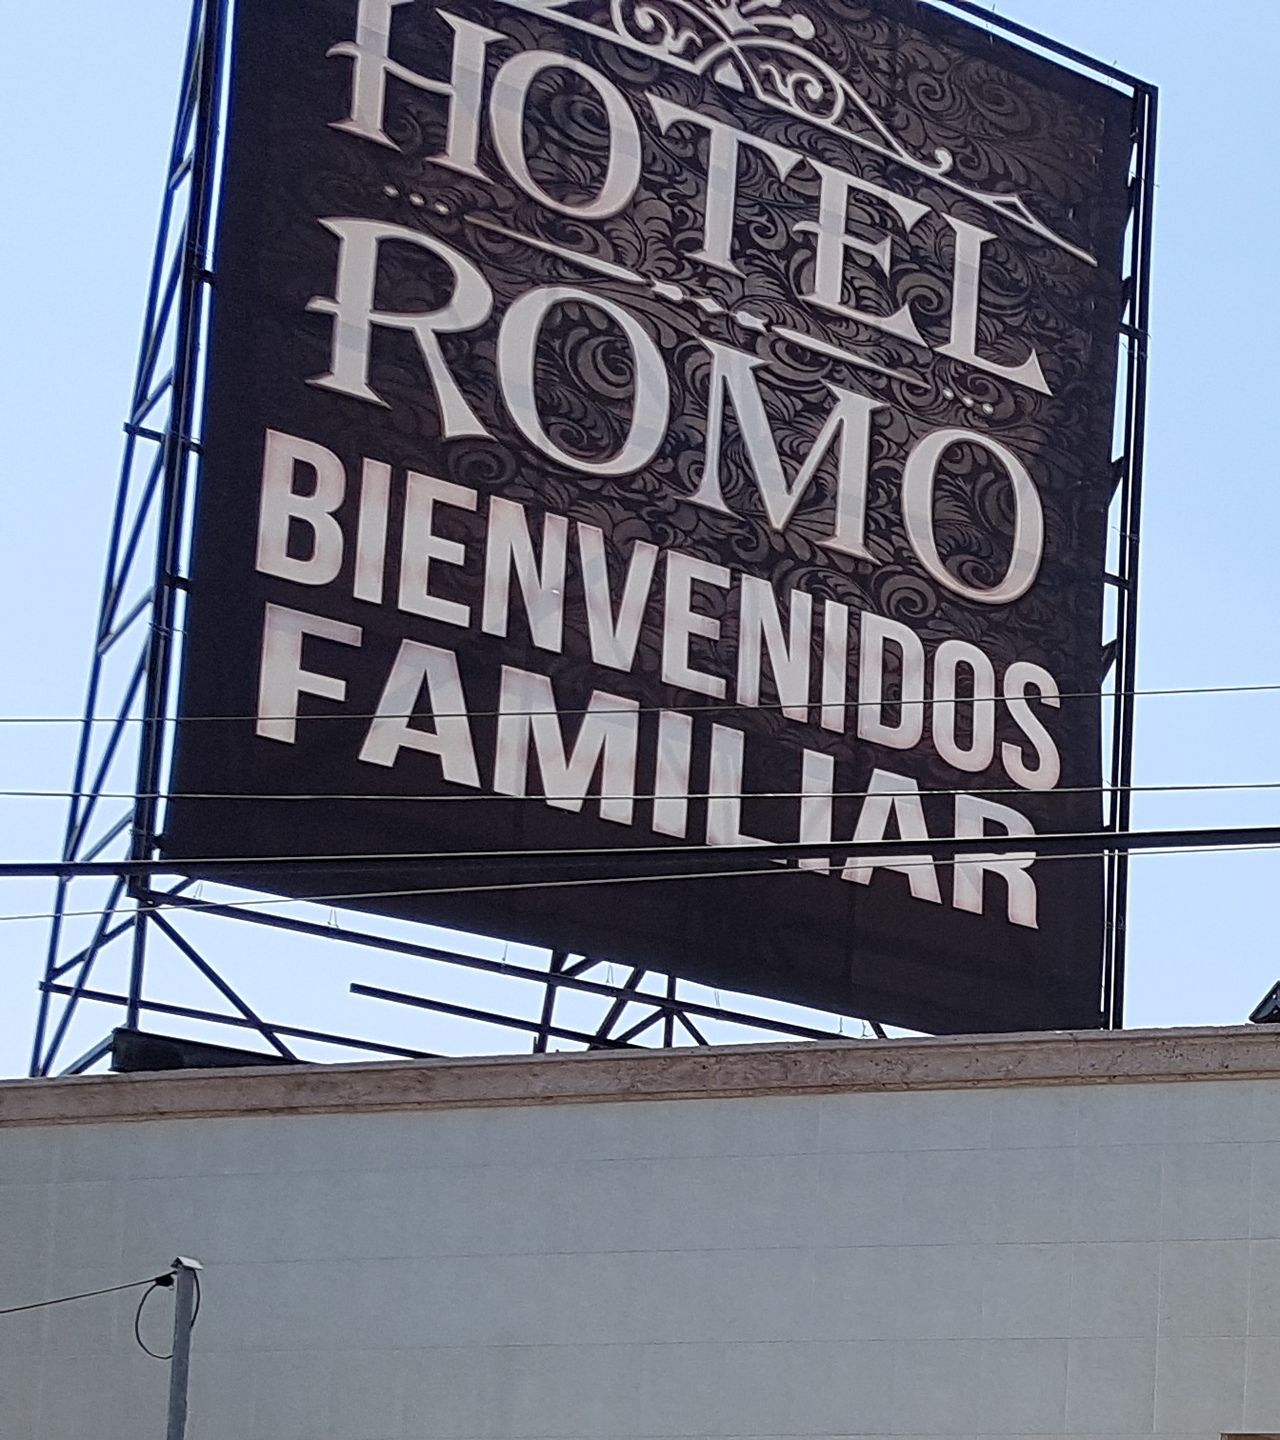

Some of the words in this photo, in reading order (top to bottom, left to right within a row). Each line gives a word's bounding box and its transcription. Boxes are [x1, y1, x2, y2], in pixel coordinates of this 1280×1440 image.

[325, 0, 1053, 397] HOTEL
[304, 215, 1045, 604] ROMO
[254, 427, 1062, 792] BIENVENIDOS
[254, 602, 1040, 930] FAMILIAR
